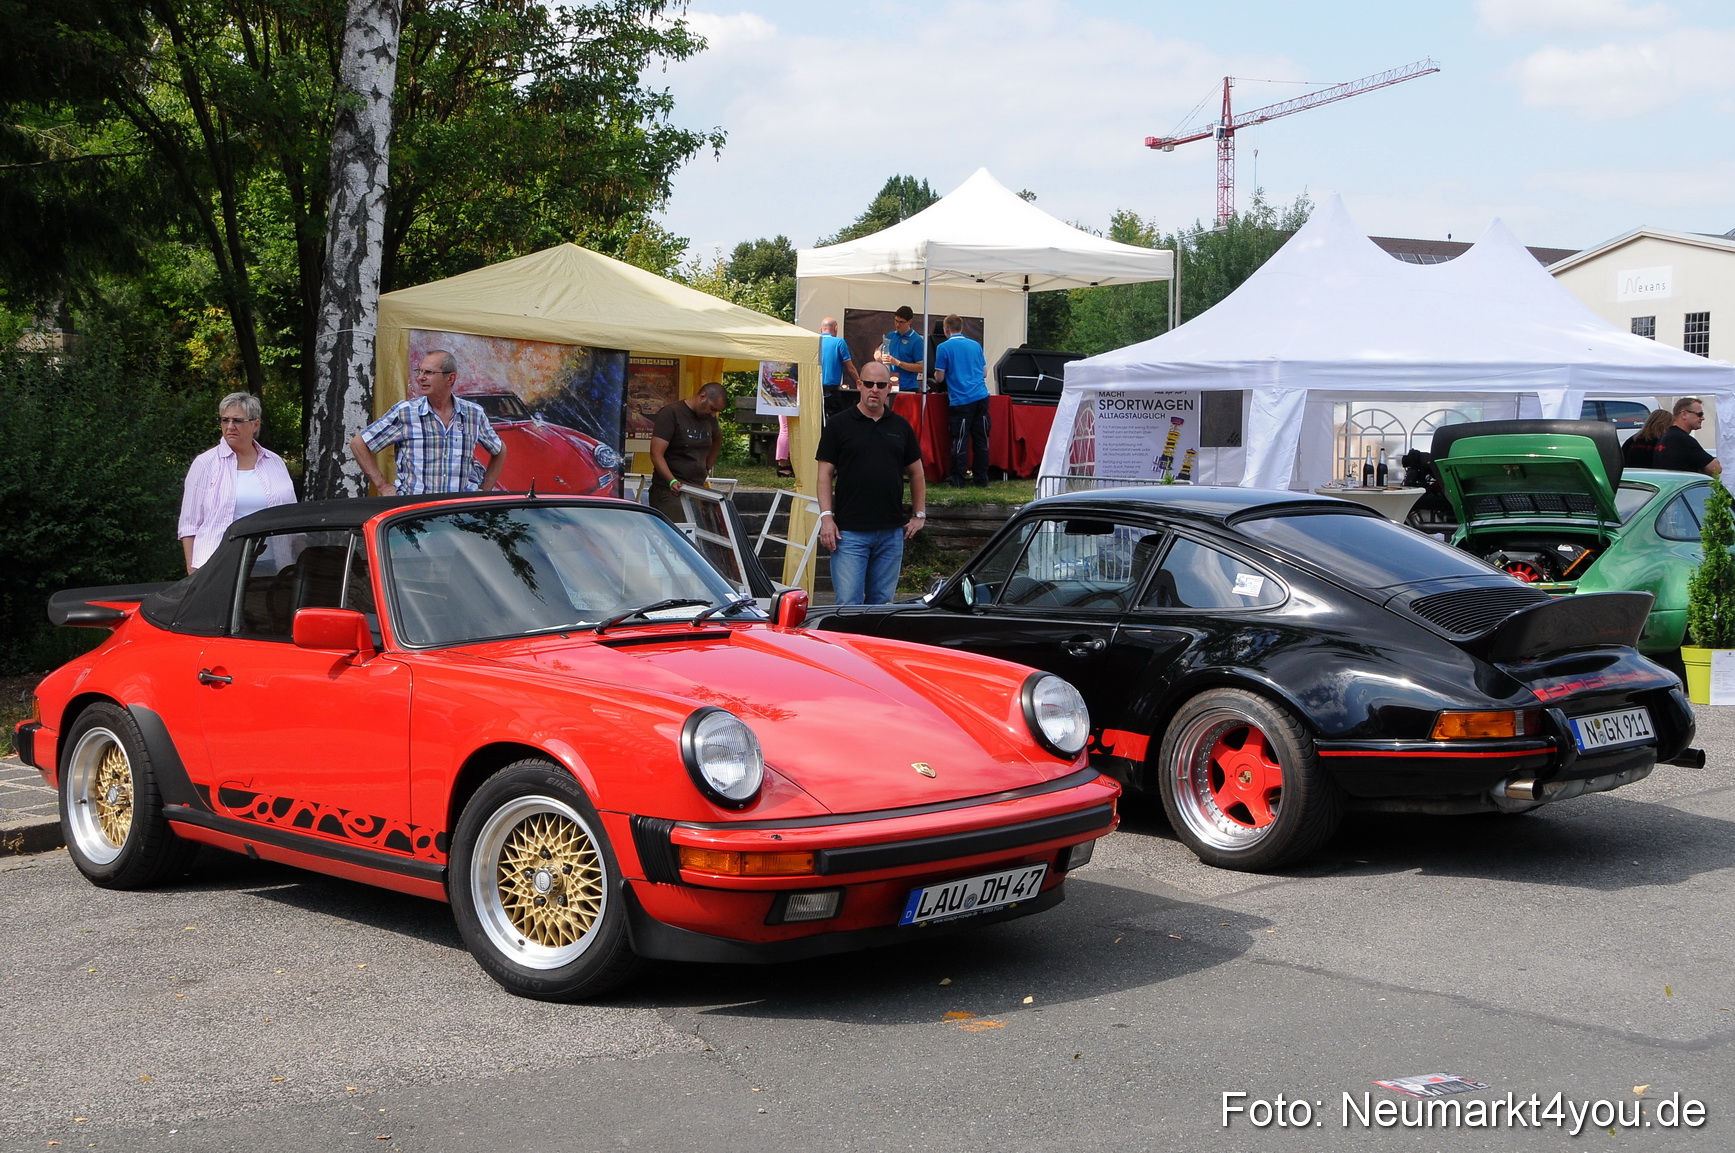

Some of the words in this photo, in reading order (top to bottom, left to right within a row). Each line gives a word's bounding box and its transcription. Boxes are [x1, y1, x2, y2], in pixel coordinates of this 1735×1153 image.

[1623, 276, 1666, 295] Nexans
[1098, 412, 1166, 420] ALLTAGSTAUGLICH
[1099, 399, 1194, 411] SPORTWAGEN
[1583, 720, 1599, 745] N
[1602, 716, 1625, 742] GX
[1622, 712, 1650, 738] 911
[210, 778, 446, 861] Carrera
[916, 883, 968, 918] LAU
[977, 874, 1012, 906] DH
[1011, 868, 1044, 898] 47
